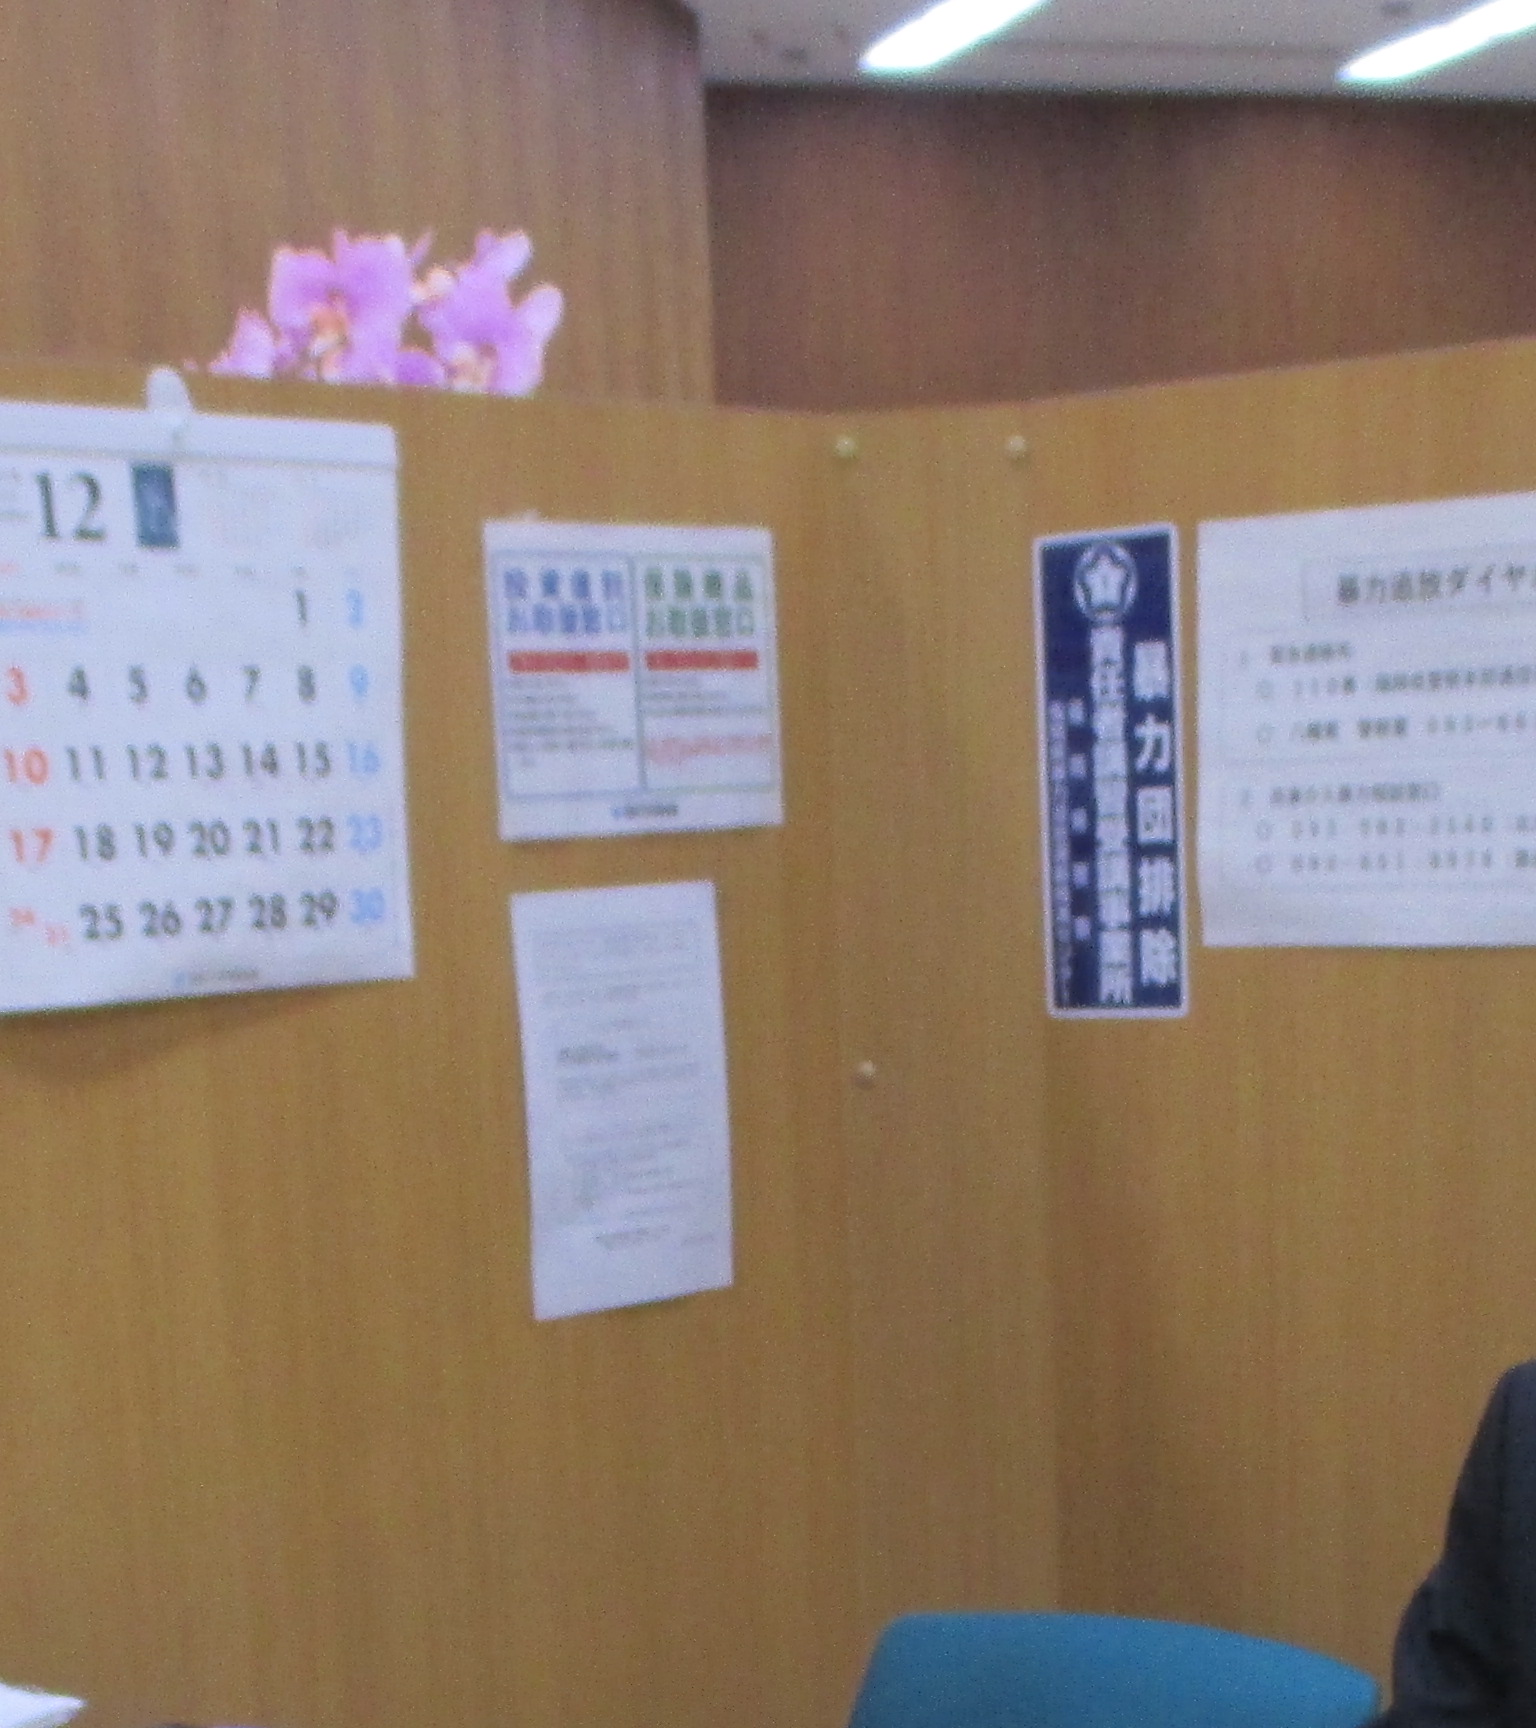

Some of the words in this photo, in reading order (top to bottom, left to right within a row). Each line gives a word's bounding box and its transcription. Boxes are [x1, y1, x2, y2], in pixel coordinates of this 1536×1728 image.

[35, 471, 107, 544] 12
[293, 588, 310, 628] 1
[6, 665, 30, 708] 3
[67, 666, 91, 702] 4
[127, 665, 150, 706] 5
[184, 666, 209, 706] 6
[242, 663, 262, 701] 7
[296, 664, 317, 703] 8
[3, 746, 51, 786] 10
[65, 744, 107, 783] 11
[126, 743, 169, 782] 12
[184, 742, 227, 783] 13
[241, 743, 281, 778] 14
[295, 740, 333, 779] 15
[9, 826, 56, 863] 17
[75, 823, 118, 863] 18
[134, 820, 176, 858] 19
[188, 819, 232, 859] 20
[242, 818, 281, 857] 21
[297, 816, 336, 855] 22
[79, 903, 125, 942] 25
[138, 901, 184, 939] 26
[195, 896, 235, 936] 27
[248, 893, 289, 933] 28
[300, 889, 340, 929] 29
